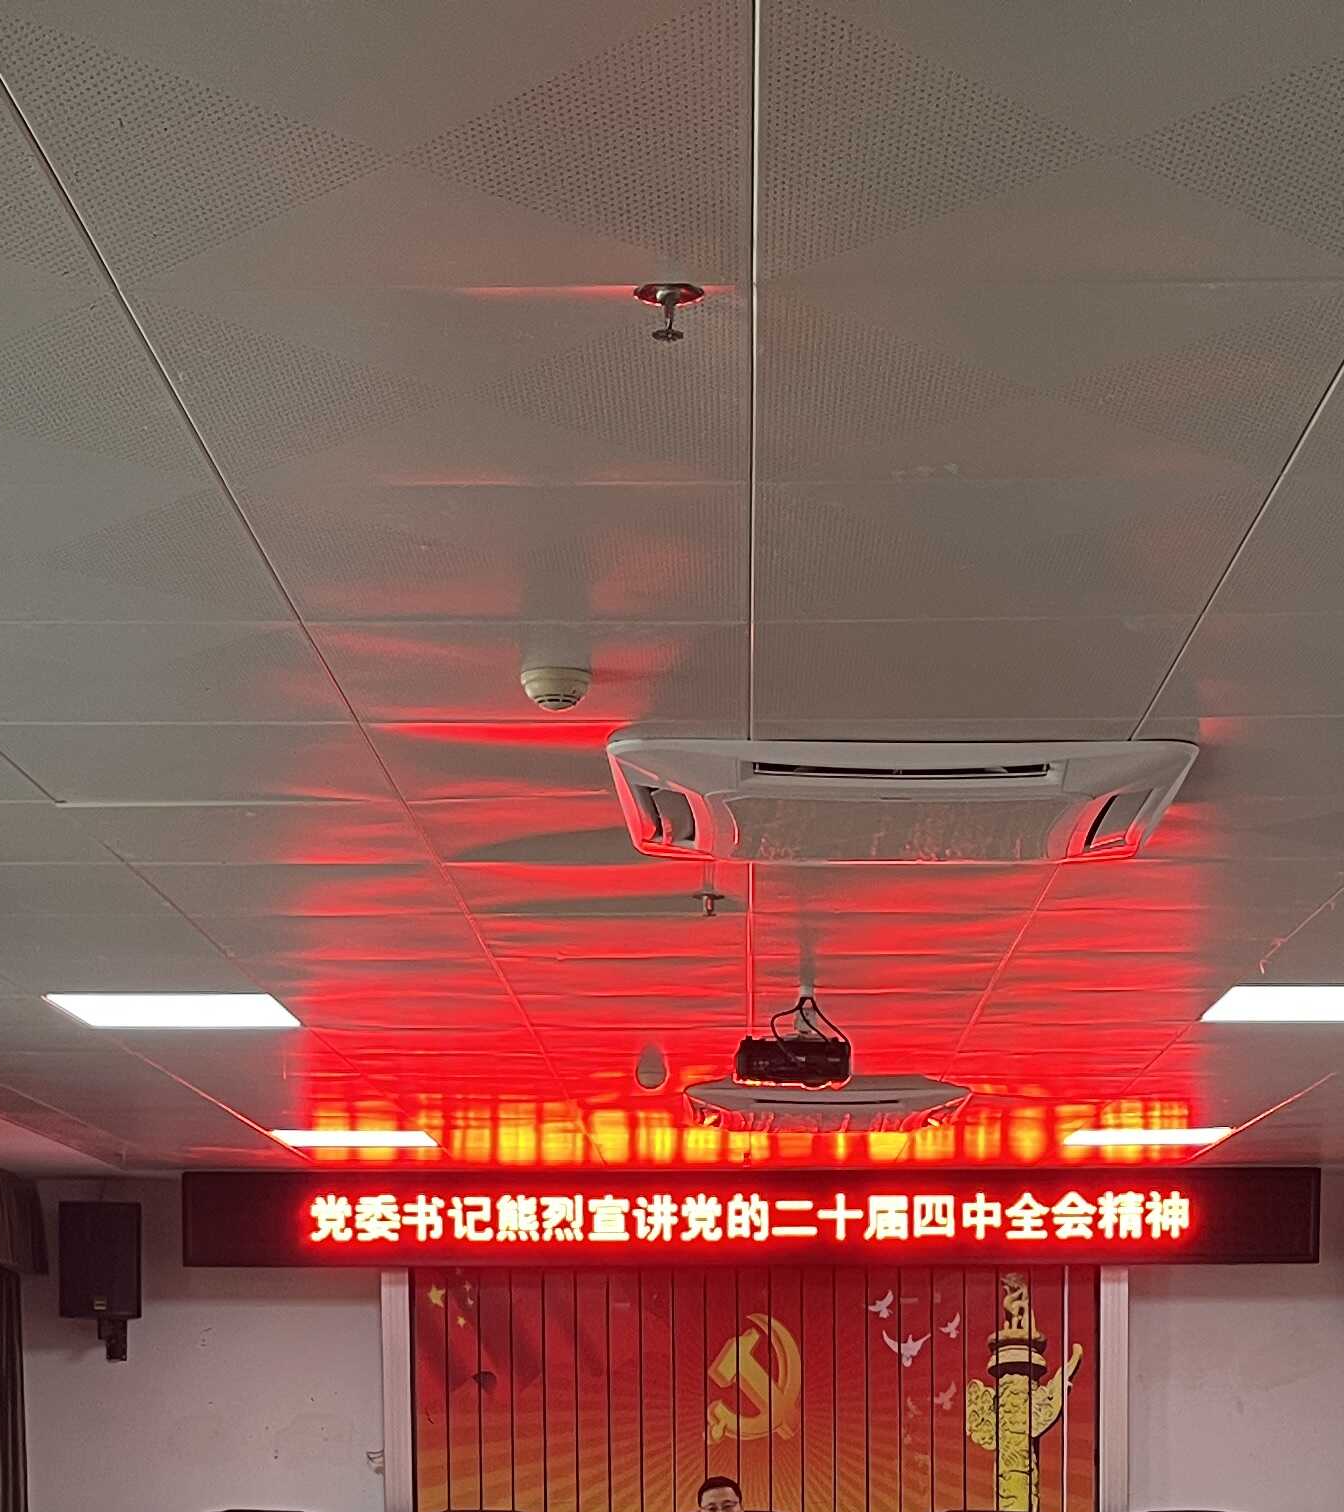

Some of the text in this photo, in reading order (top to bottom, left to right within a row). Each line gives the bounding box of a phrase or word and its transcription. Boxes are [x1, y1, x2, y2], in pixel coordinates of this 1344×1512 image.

[311, 1192, 1190, 1242] 党委书记熊烈宣讲党的二十届四中全会精神
